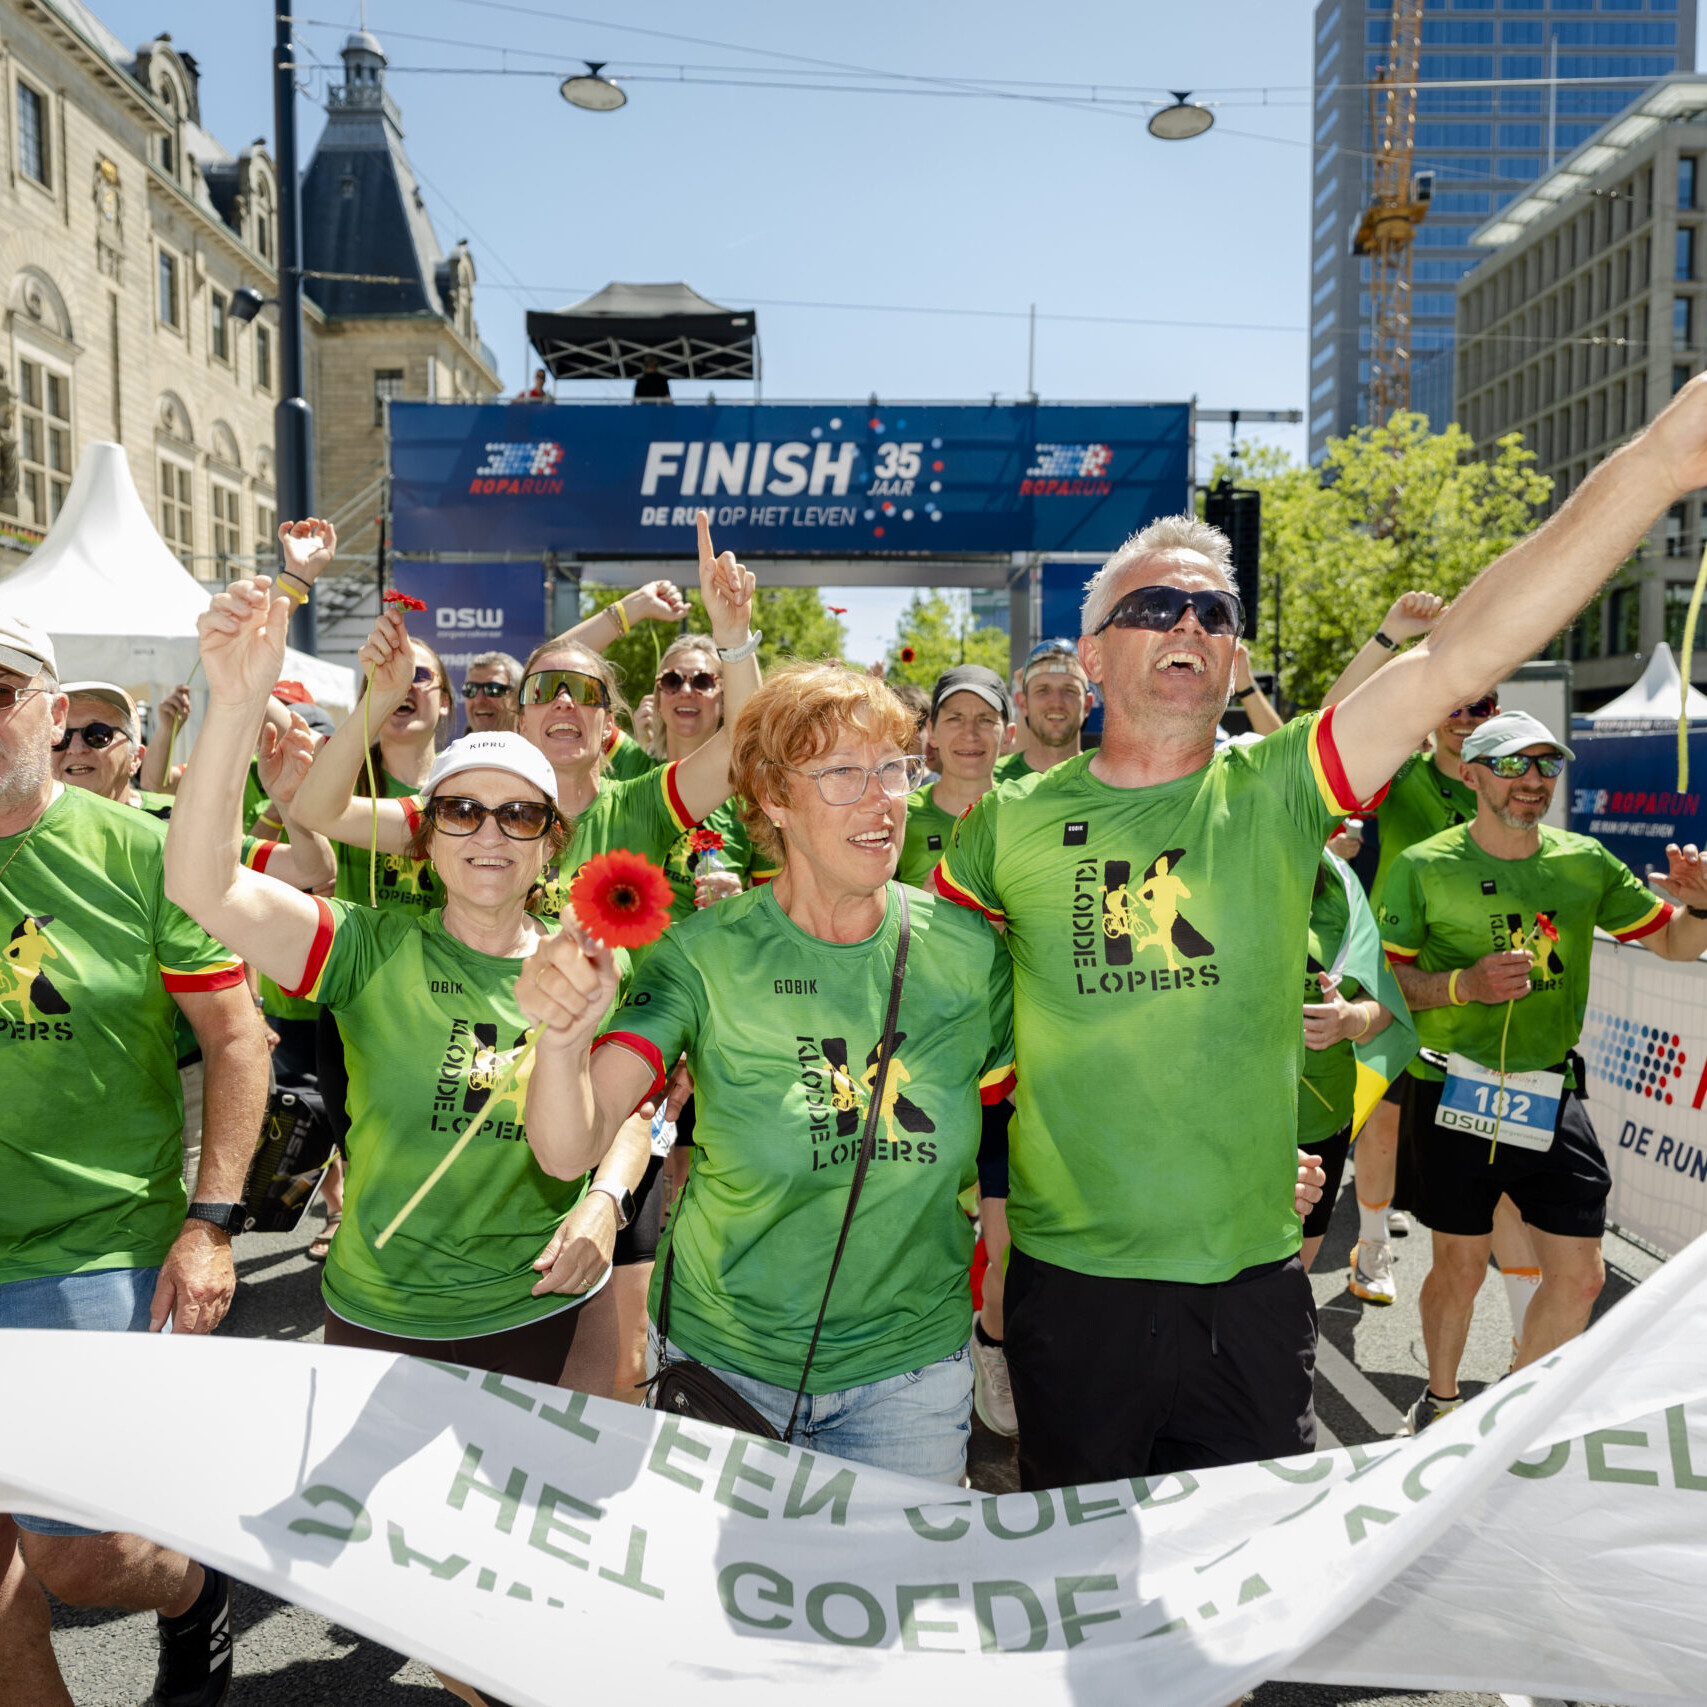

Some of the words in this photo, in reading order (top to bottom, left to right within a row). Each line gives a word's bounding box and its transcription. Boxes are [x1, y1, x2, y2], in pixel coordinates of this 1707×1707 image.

[640, 442, 856, 496] FINISH
[874, 442, 923, 479] 35
[469, 479, 564, 495] ROPARUN
[866, 480, 915, 496] JAAR
[1019, 479, 1112, 496] ROPARUN
[640, 507, 669, 526] DE
[671, 507, 715, 526] RUN
[718, 507, 747, 526] OP
[749, 507, 789, 526] HET
[792, 507, 857, 526] LEVEN
[436, 608, 504, 629] DSW
[1610, 791, 1700, 816] ROPARUN
[428, 980, 464, 994] OBIK
[774, 979, 819, 995] GOBIK
[1076, 963, 1220, 995] LOPERS
[1475, 1085, 1532, 1123] 182
[1441, 1110, 1497, 1135] DSW
[1619, 1120, 1653, 1157] DE
[1655, 1134, 1707, 1183] RUN
